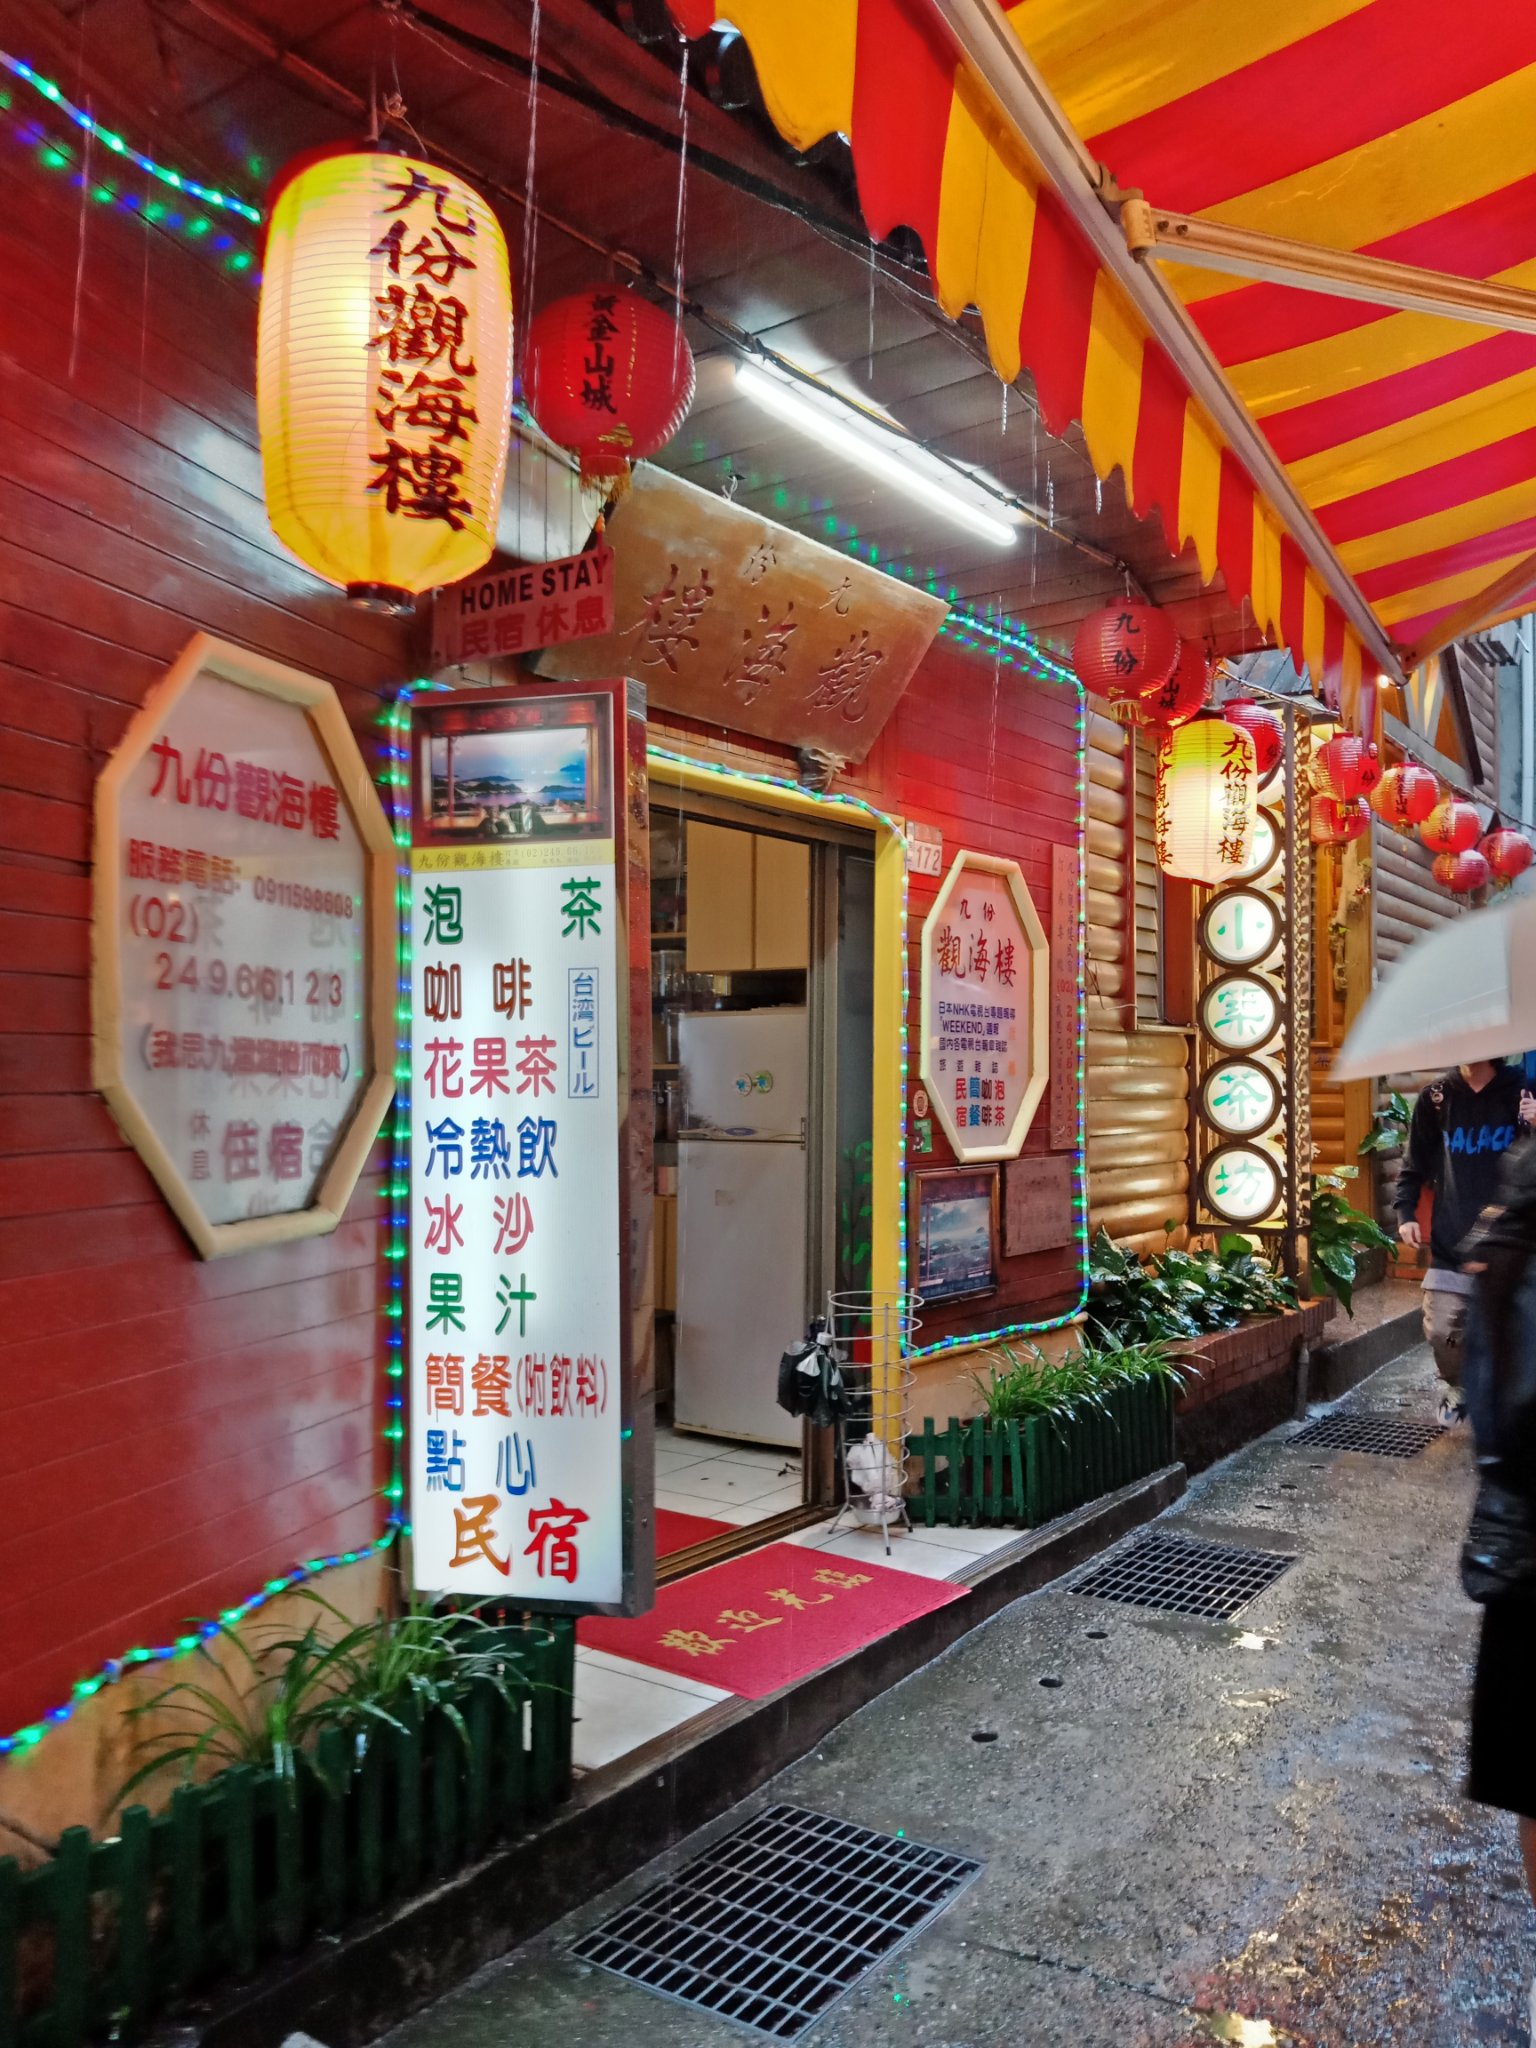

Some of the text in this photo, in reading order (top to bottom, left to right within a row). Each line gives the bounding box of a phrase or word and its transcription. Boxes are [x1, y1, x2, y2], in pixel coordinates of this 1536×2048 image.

[364, 167, 480, 532] 九份觀海樓
[460, 555, 608, 615] HOME STAY
[1112, 611, 1140, 676] 九份
[150, 735, 341, 842] 九份觀海樓
[1217, 732, 1252, 865] 九份觀海樓
[418, 849, 504, 869] 九份觀海樓
[916, 846, 941, 872] 172
[130, 894, 199, 944] (02)
[422, 876, 602, 946] 泡茶
[960, 898, 996, 921] 九份
[936, 925, 1017, 988] 觀海樓
[423, 957, 533, 1022] 咖啡
[572, 972, 595, 1095] 台湾ビール
[423, 1034, 558, 1099] 花果茶
[222, 1119, 304, 1183] 住宿
[424, 1115, 558, 1180] 冷熱飲
[424, 1191, 534, 1256] 冰沙
[425, 1272, 537, 1338] 果汁
[425, 1429, 536, 1496] 點心
[448, 1494, 591, 1584] 民宿
